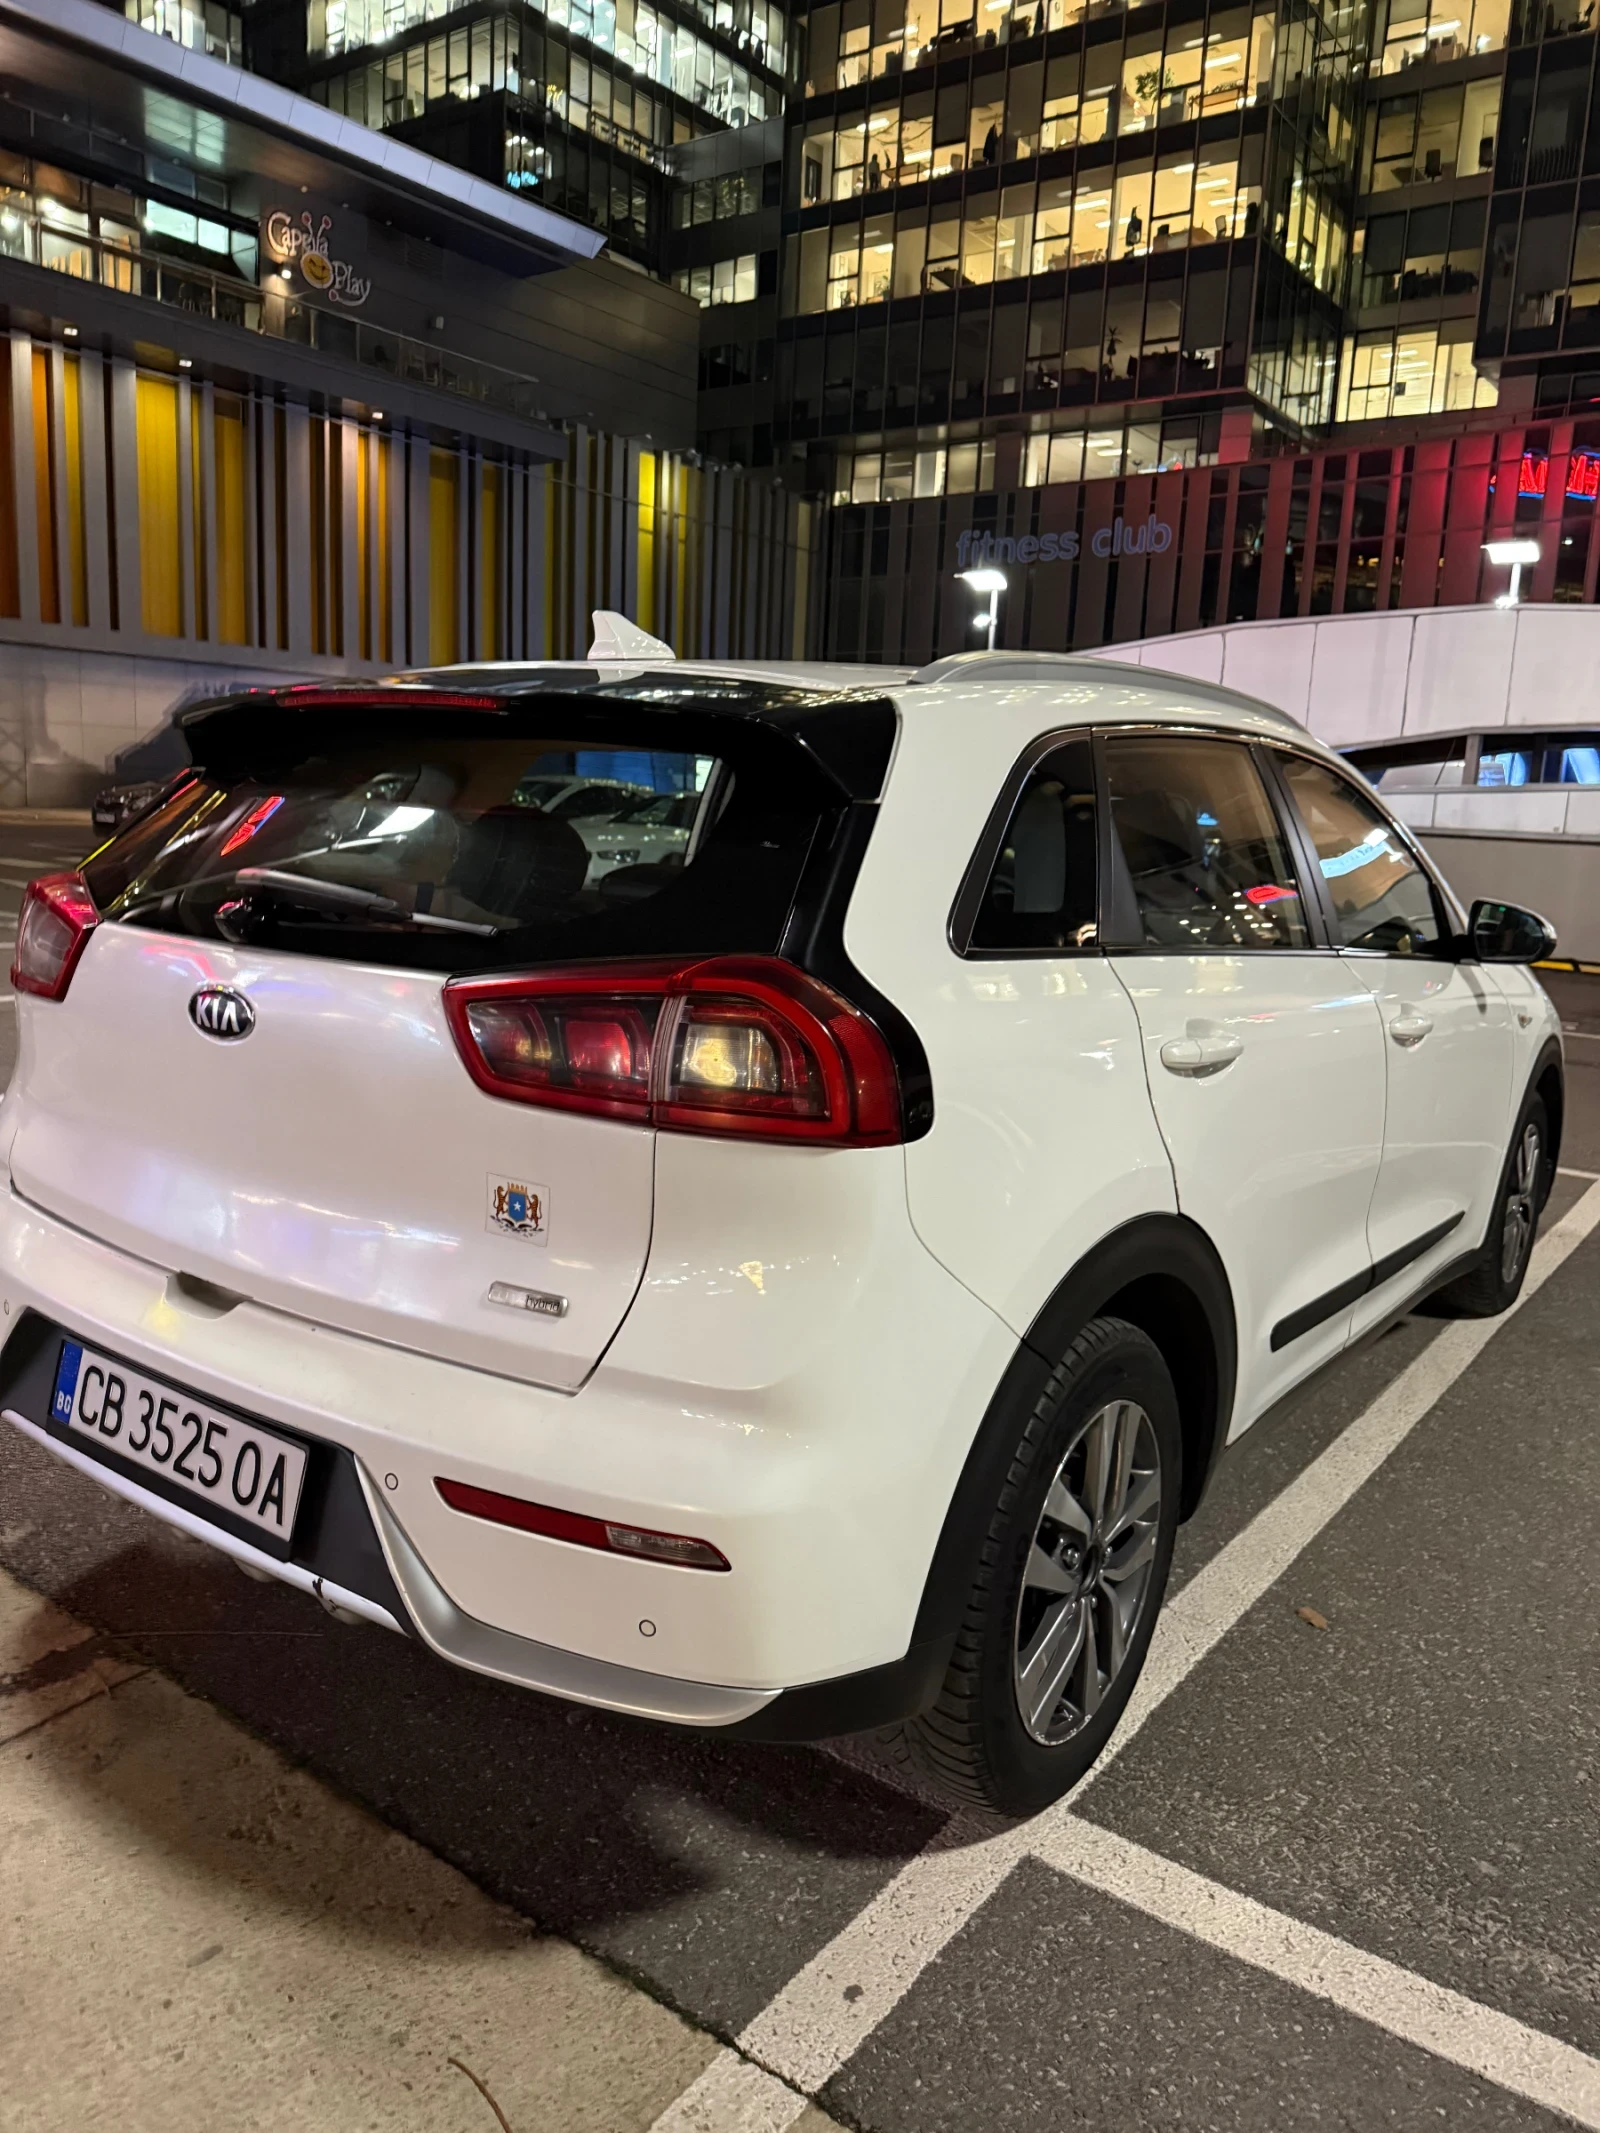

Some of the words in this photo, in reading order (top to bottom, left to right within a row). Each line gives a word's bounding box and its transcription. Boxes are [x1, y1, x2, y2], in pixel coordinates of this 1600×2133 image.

[331, 261, 371, 306] Play
[956, 529, 1079, 567] fitness
[1092, 513, 1172, 558] club
[196, 995, 240, 1032] KIA
[57, 1390, 71, 1414] BG
[78, 1365, 126, 1438] CB
[128, 1390, 229, 1488] 3525
